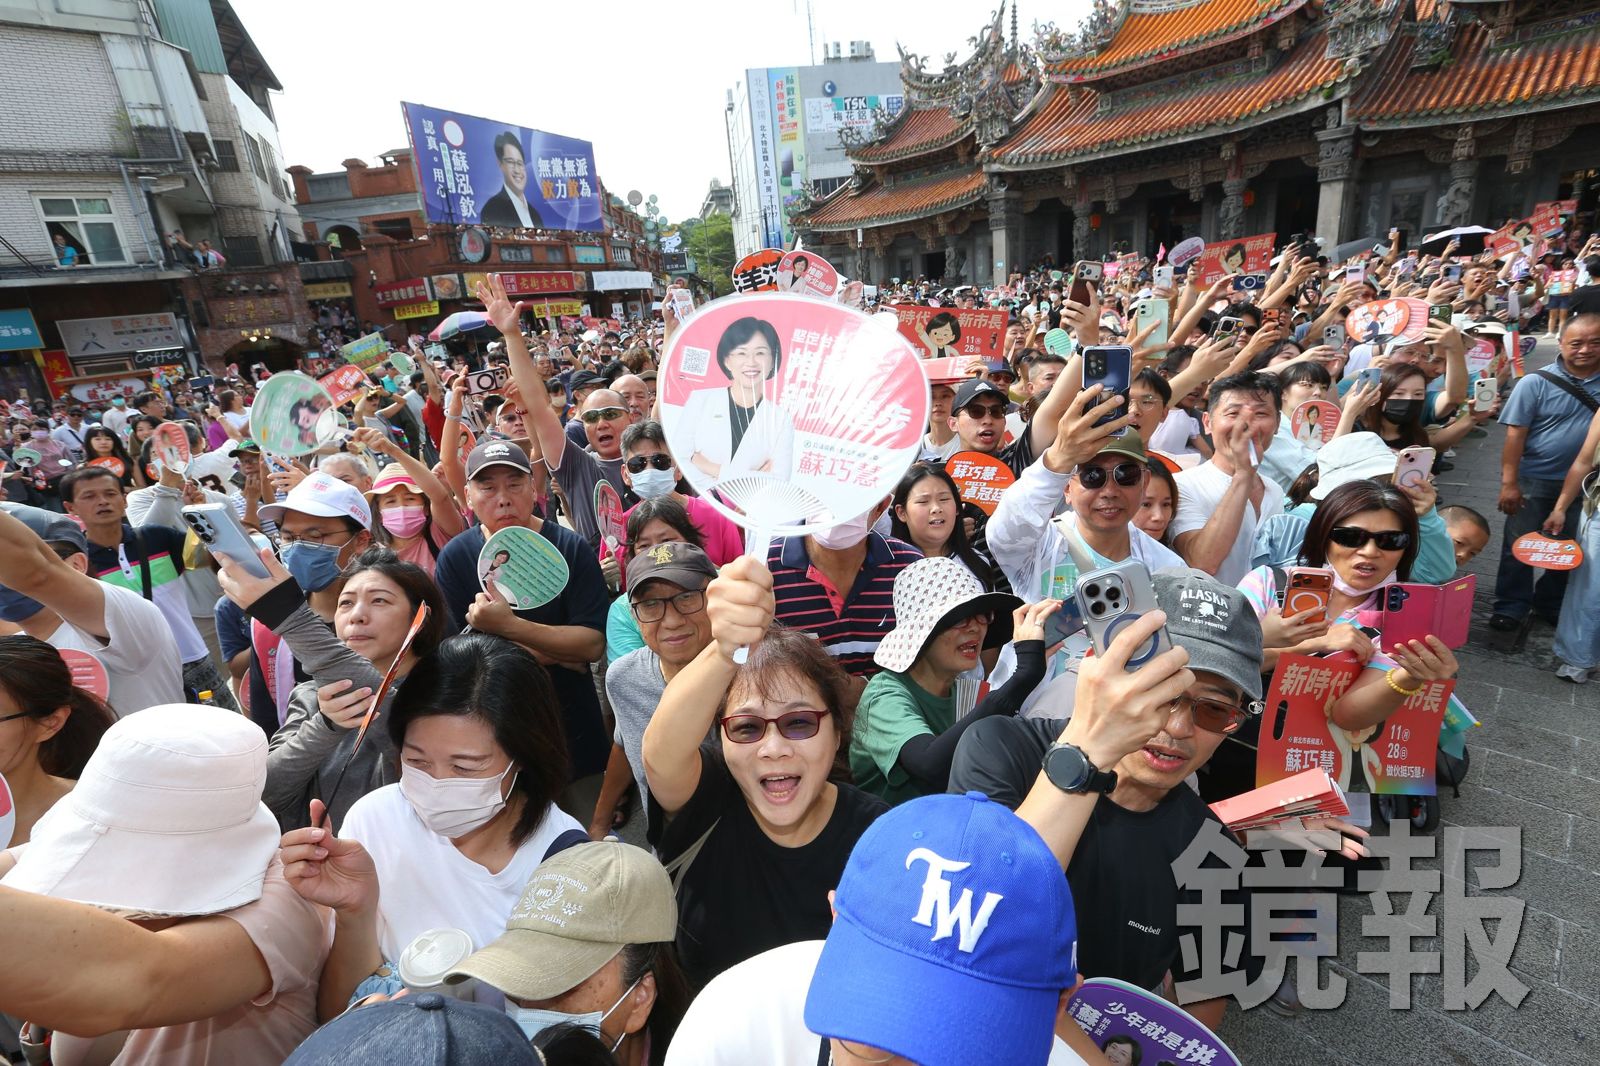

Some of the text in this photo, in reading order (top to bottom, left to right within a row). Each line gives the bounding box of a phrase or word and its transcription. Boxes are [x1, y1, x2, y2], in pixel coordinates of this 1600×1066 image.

[844, 97, 866, 110] TSK
[538, 157, 588, 177] 無黨無派
[451, 149, 477, 218] 蘇泓欽
[958, 312, 1003, 329] 新市長
[135, 351, 183, 363] Coffee
[797, 451, 882, 488] 蘇巧慧
[951, 464, 998, 481] 蘇巧慧
[1180, 589, 1229, 609] ALASKA
[1279, 662, 1353, 701] 新時代
[1285, 747, 1336, 773] 蘇巧慧
[905, 847, 1004, 953] TW
[1127, 920, 1161, 935] montbell
[1104, 1001, 1218, 1066] 少年就是拼
